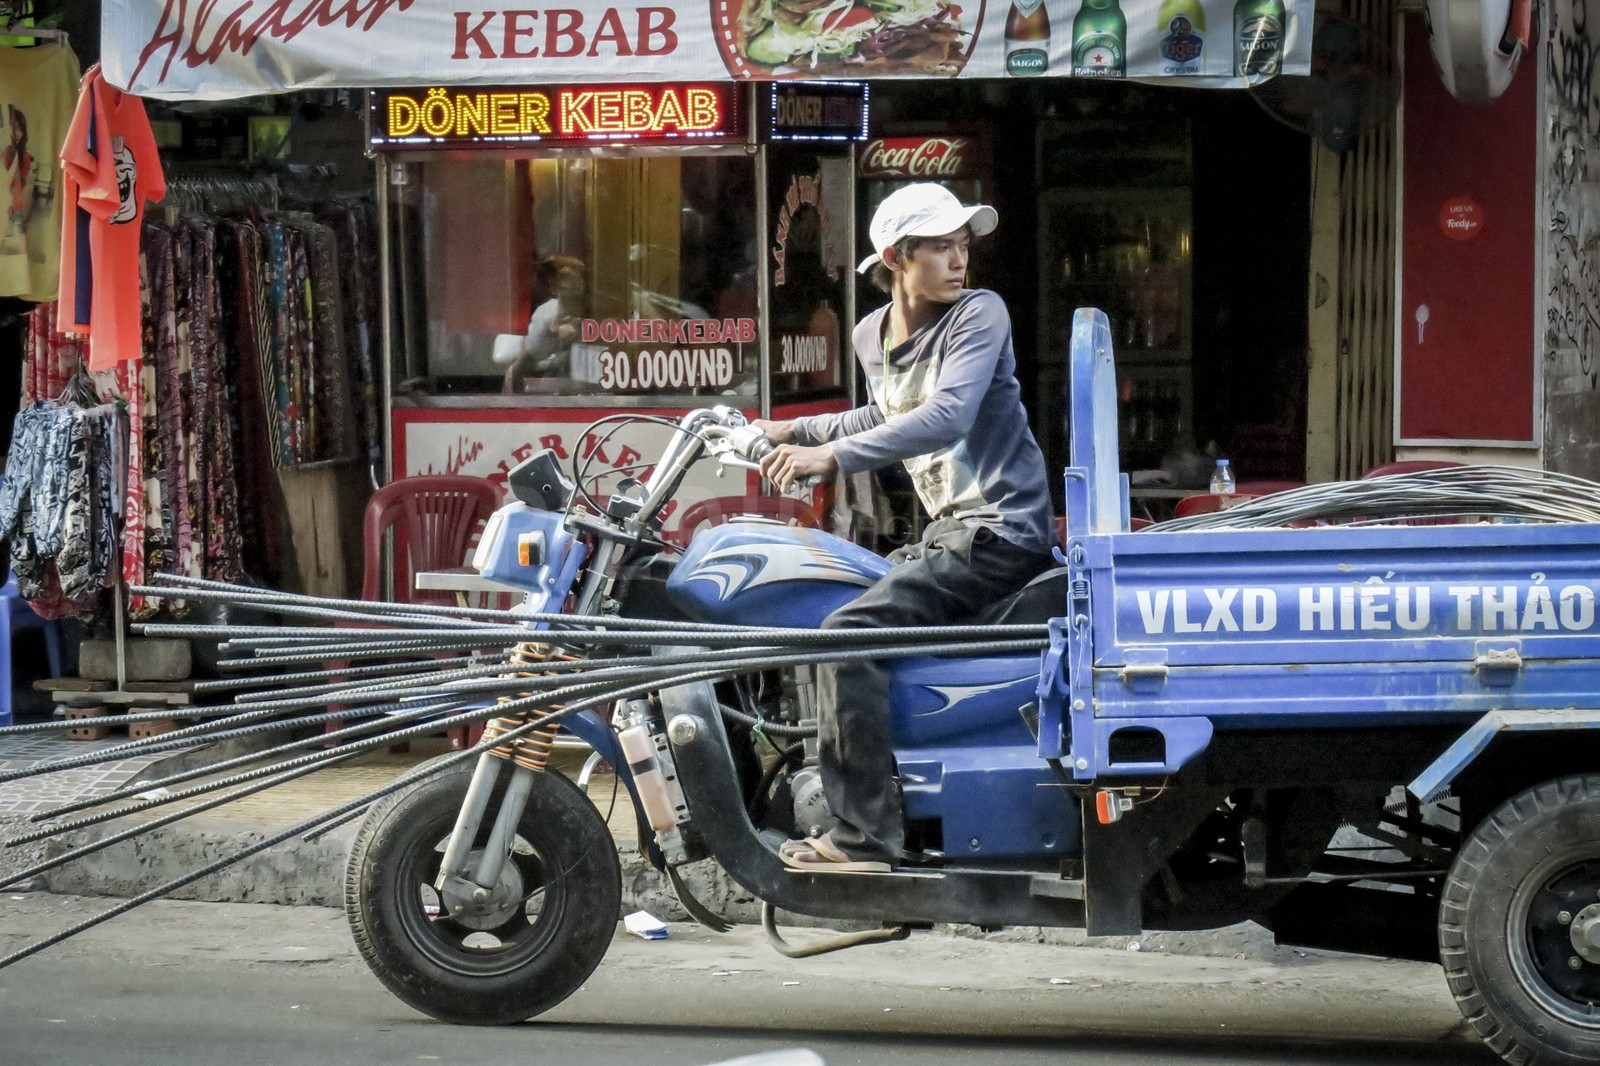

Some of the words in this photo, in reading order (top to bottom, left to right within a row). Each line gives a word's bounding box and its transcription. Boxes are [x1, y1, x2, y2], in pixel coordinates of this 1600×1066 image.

[451, 7, 679, 60] KEBAB
[1240, 40, 1279, 51] SAIGON
[1011, 59, 1043, 67] SAIGON
[1075, 67, 1122, 77] Heineken
[388, 87, 551, 136] DÖNER
[561, 89, 718, 133] KEBAB
[777, 87, 822, 126] DÖNER
[860, 138, 966, 176] Coca-Cola
[581, 318, 755, 343] DONERKEBAB
[600, 349, 733, 389] 30.000VNĐ
[1137, 588, 1277, 633] VLXD
[1300, 571, 1430, 631] HIẾU
[1449, 572, 1594, 631] THẢO
